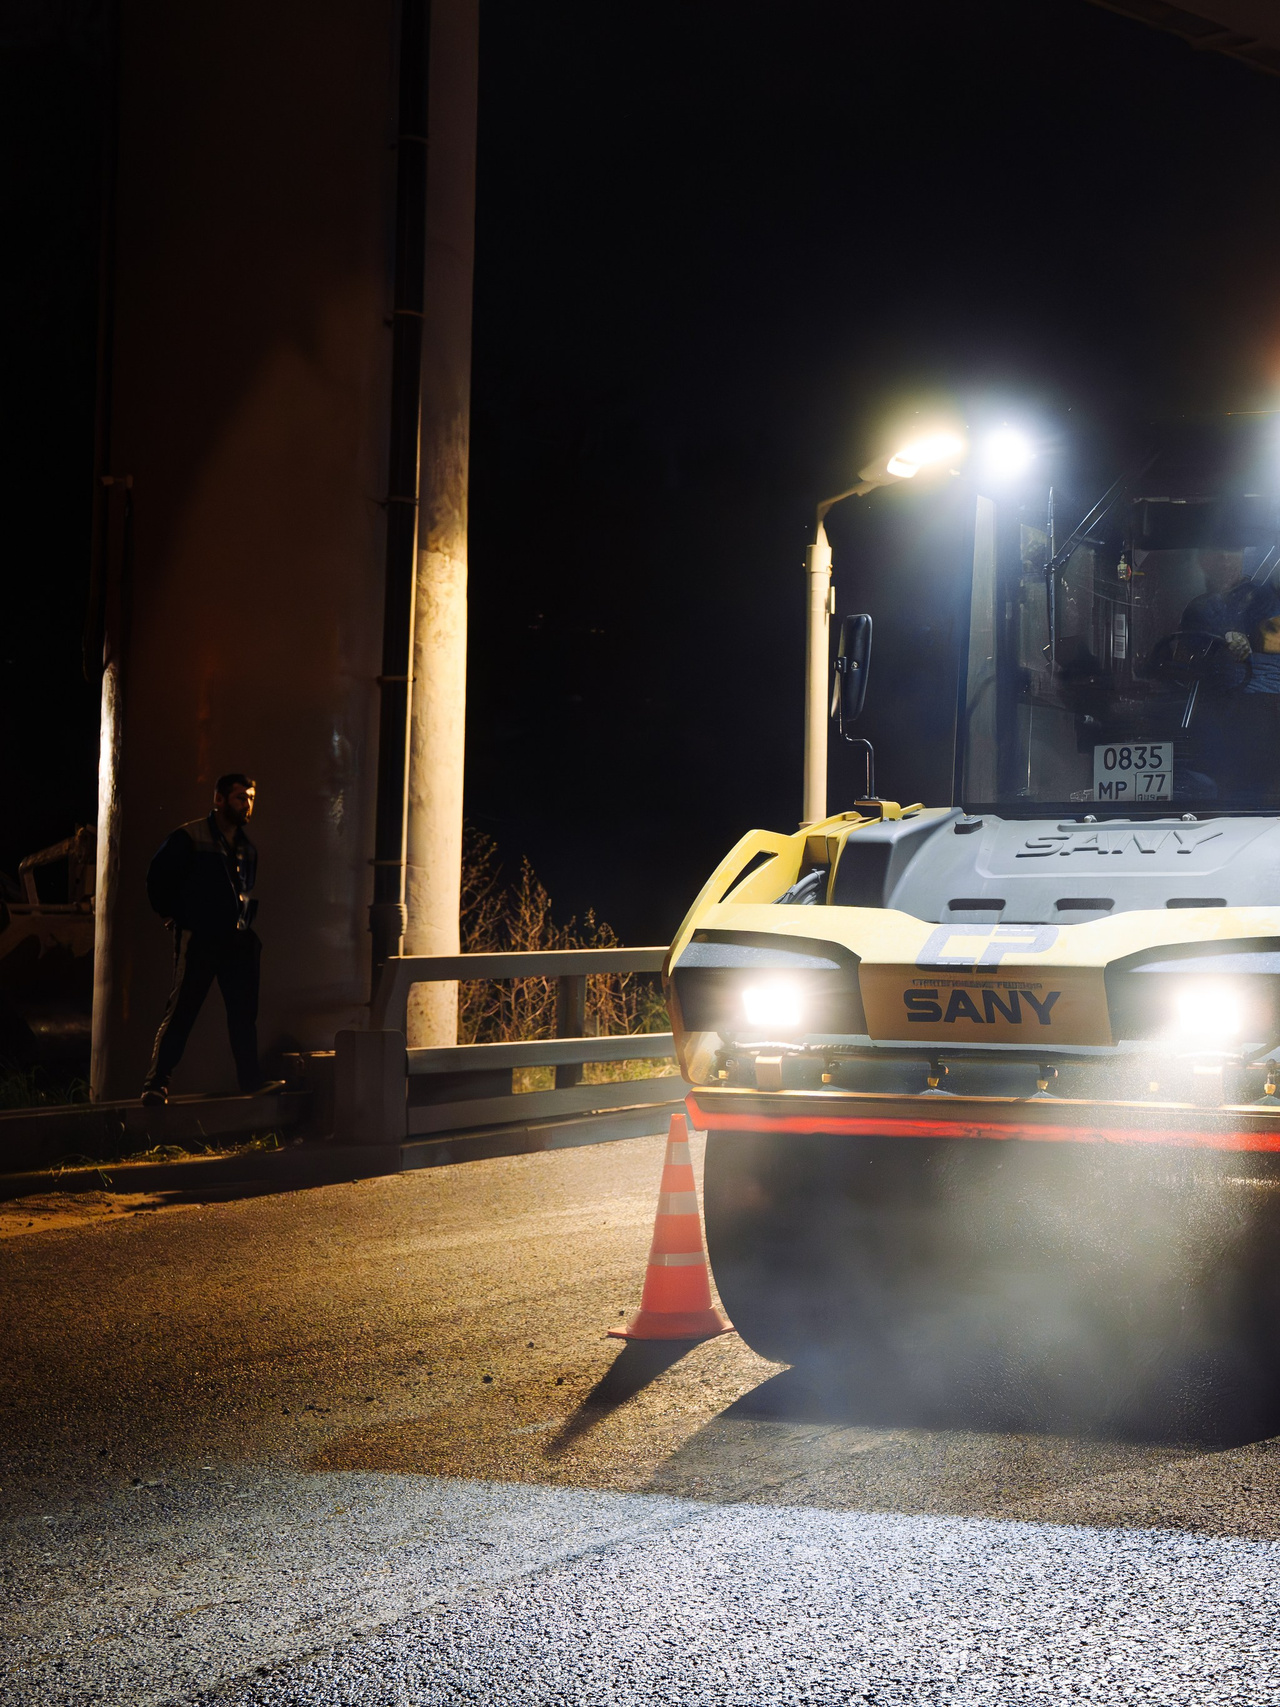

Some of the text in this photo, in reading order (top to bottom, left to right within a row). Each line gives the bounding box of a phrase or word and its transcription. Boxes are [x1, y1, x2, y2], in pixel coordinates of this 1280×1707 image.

[1104, 746, 1163, 770] 0835
[1143, 774, 1166, 792] 77
[1015, 831, 1223, 858] SANY
[903, 988, 1061, 1025] SANY
